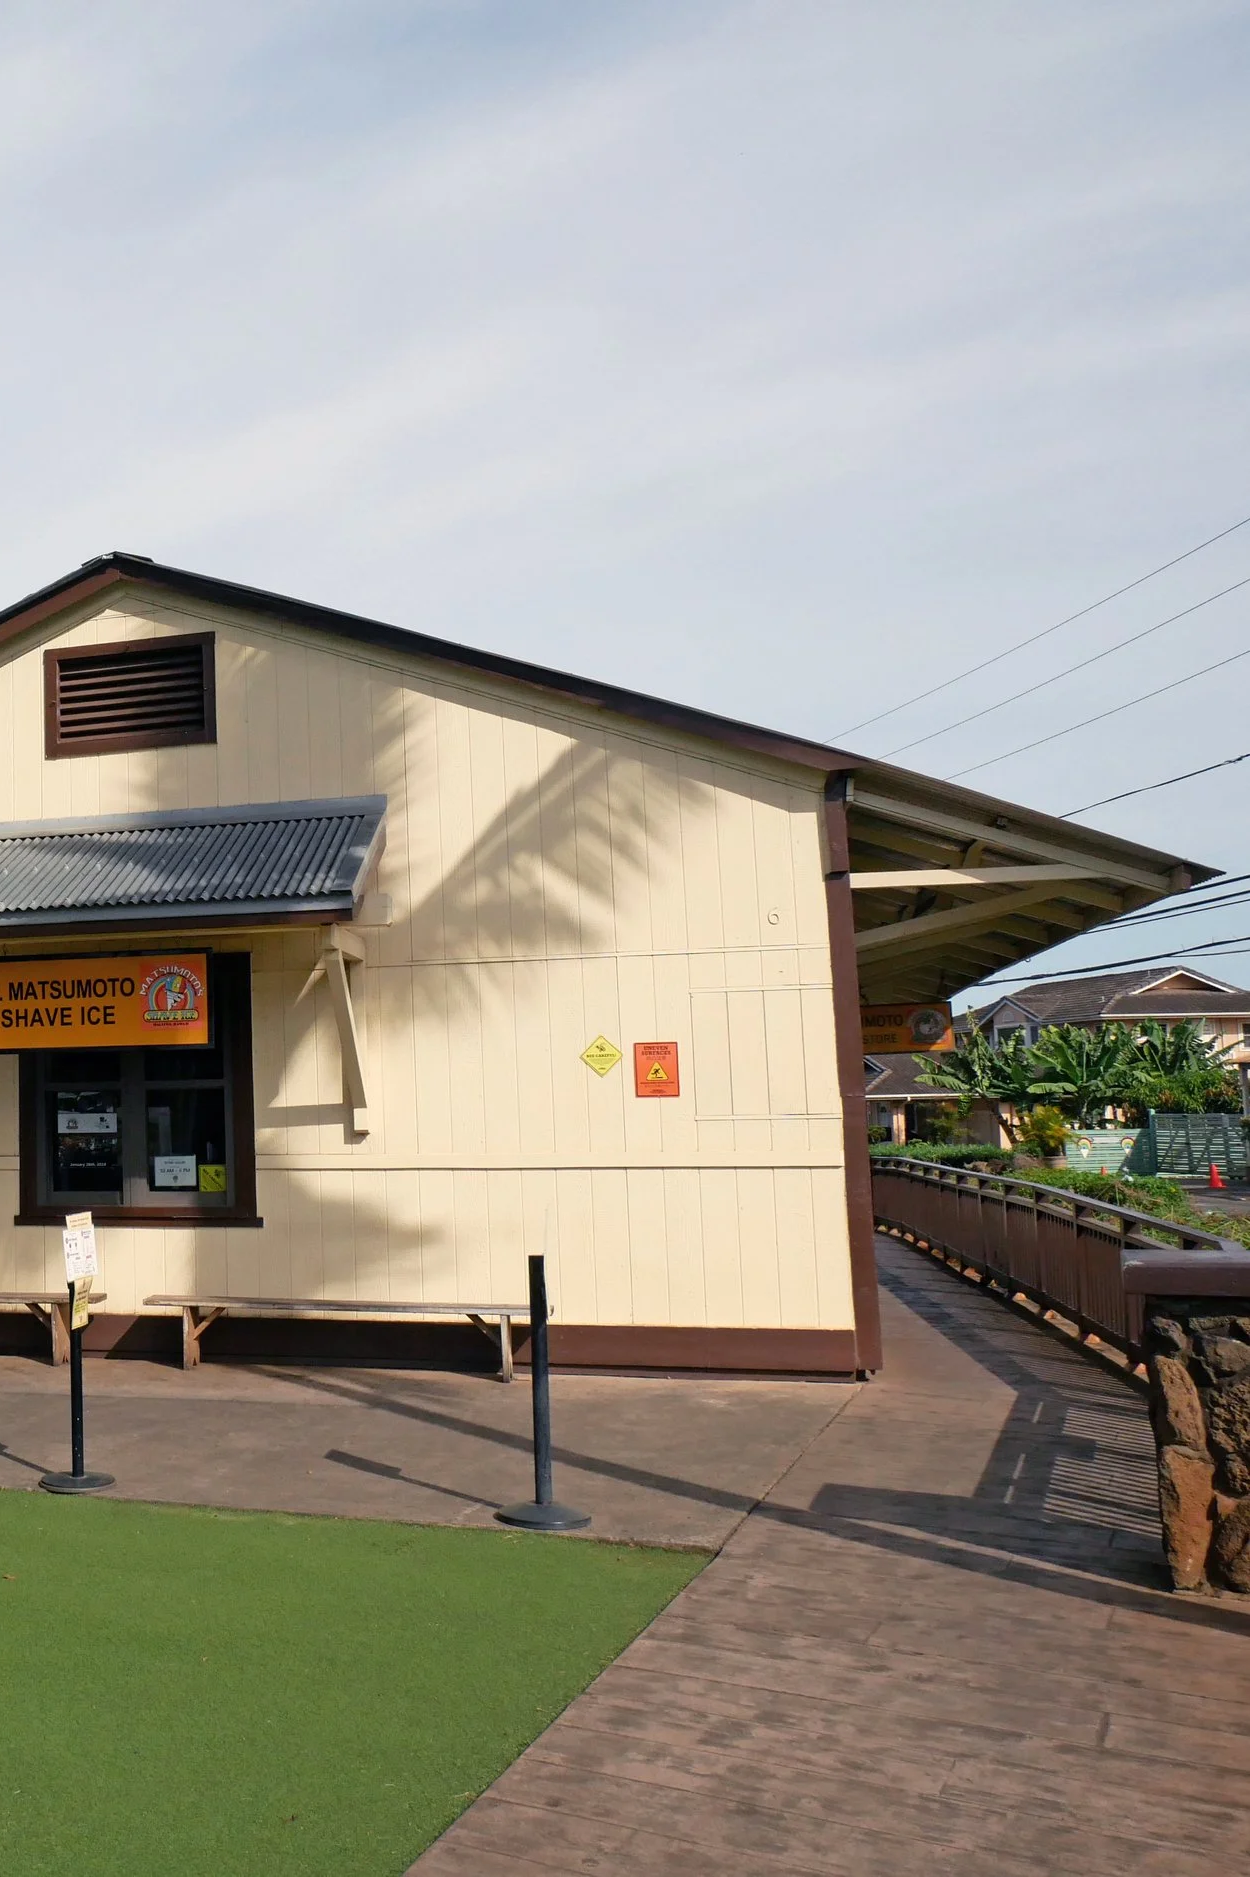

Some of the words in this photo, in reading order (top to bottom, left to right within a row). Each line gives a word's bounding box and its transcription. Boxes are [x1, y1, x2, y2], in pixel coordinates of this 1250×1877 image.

[8, 977, 136, 1001] MATSUMOTO
[0, 1007, 73, 1028] SHAVE
[80, 1005, 116, 1026] ICE
[861, 1014, 904, 1028] MOTO
